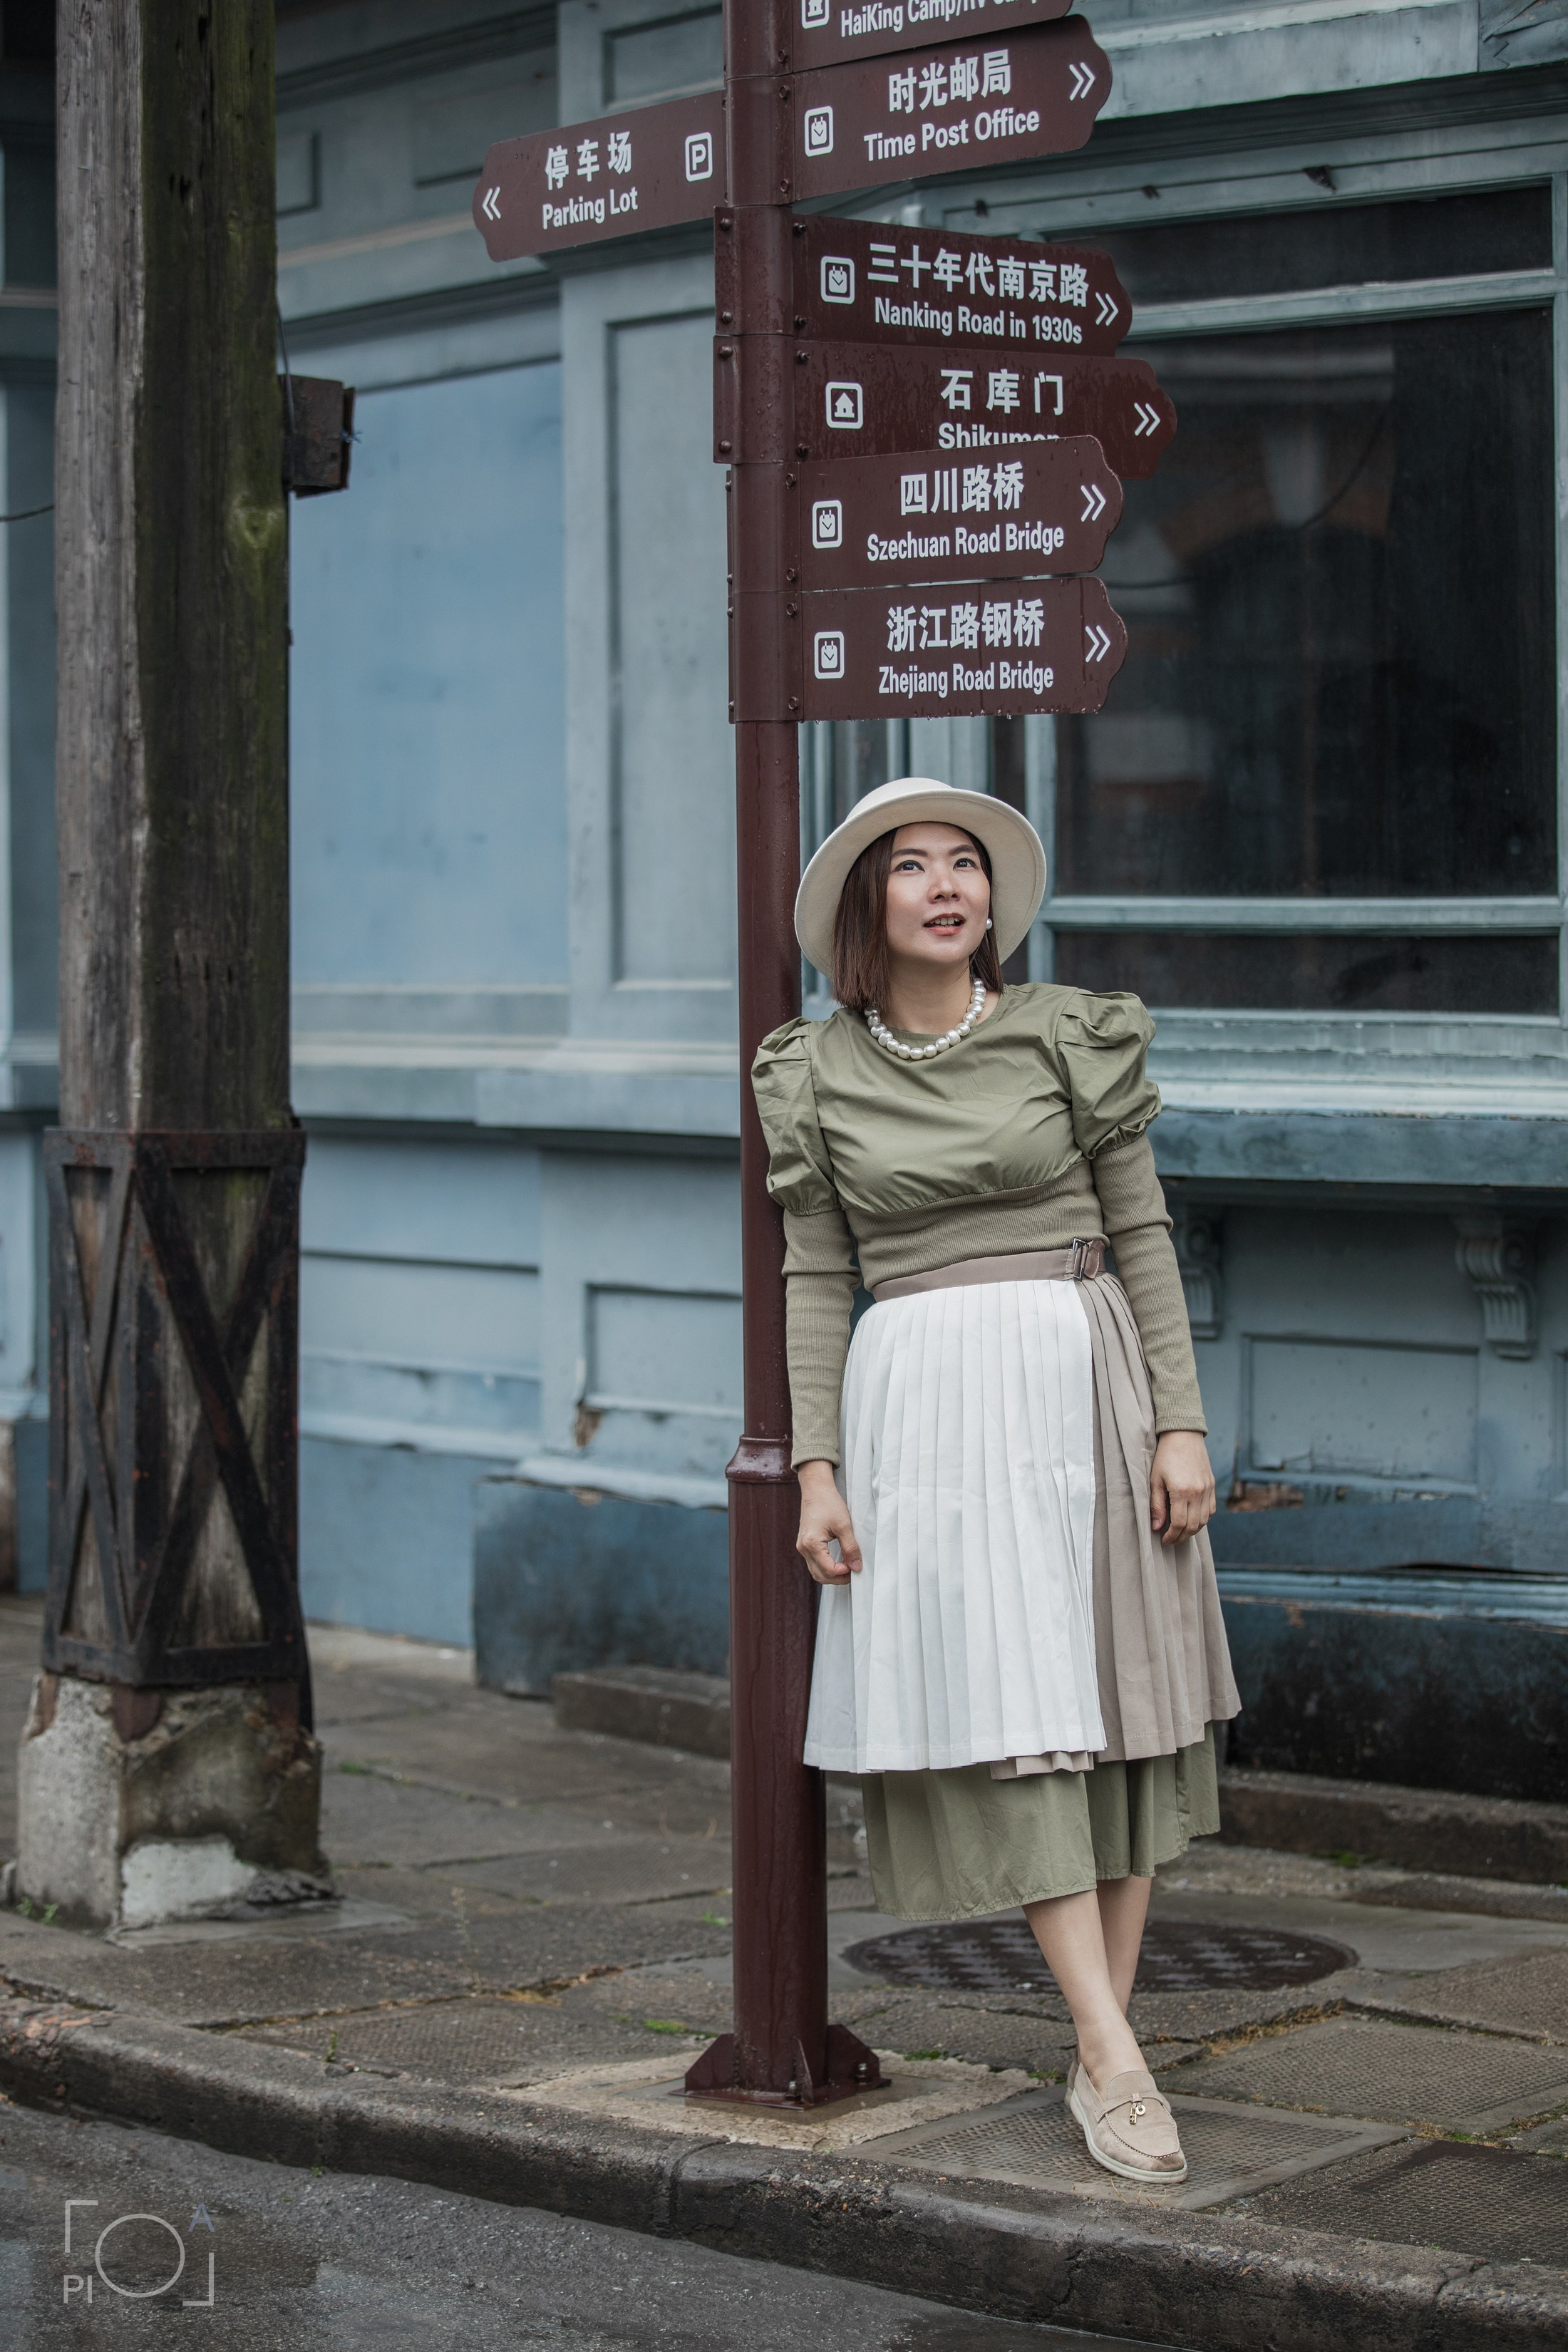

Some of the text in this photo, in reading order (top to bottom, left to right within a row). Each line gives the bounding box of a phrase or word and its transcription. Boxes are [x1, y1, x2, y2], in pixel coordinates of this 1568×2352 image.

[840, 2, 903, 38] HaiKing
[888, 48, 1011, 114] 时光邮局
[691, 143, 707, 171] P
[863, 108, 1041, 162] Time Post Office
[544, 130, 632, 191] 停车场
[542, 186, 639, 230] Parking Lot
[867, 242, 1090, 308] 三十年代南京路
[874, 296, 1083, 345] Nanking Road in 1930s
[939, 368, 1065, 416] 石库门
[938, 421, 1061, 450] Shiku
[900, 461, 1025, 516] 四川路桥
[867, 520, 1064, 562] Szechuan Road Bridge
[886, 598, 1045, 652] 浙江路钢桥
[878, 660, 1054, 699] Zhejiang Road Bridge
